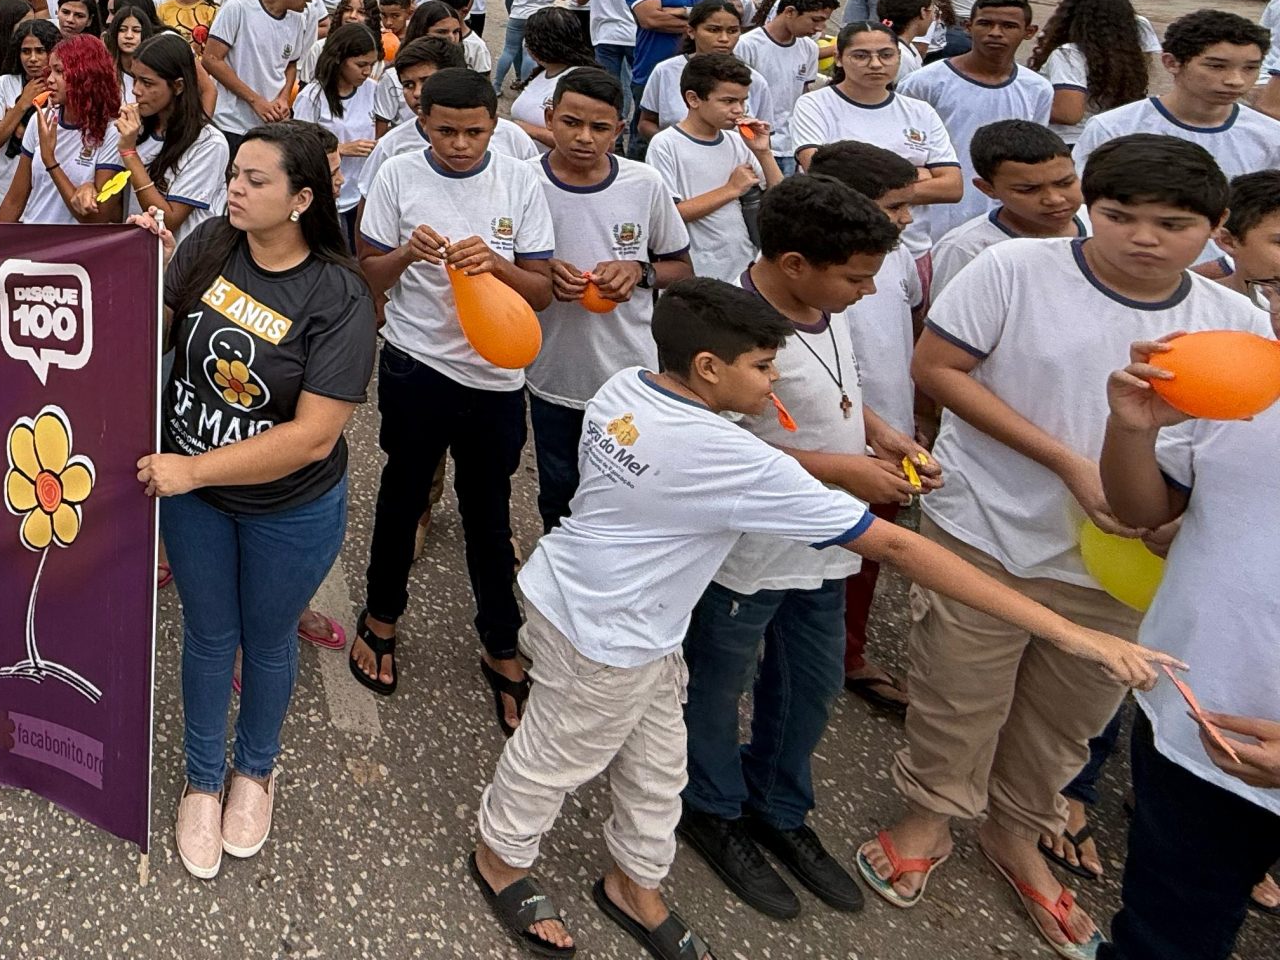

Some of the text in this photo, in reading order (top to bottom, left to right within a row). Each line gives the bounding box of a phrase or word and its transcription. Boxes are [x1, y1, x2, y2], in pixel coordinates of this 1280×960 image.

[13, 285, 79, 308] DISQUE
[12, 304, 78, 341] 100
[226, 296, 288, 339] ANOS
[599, 437, 615, 455] do
[612, 448, 650, 476] Mel
